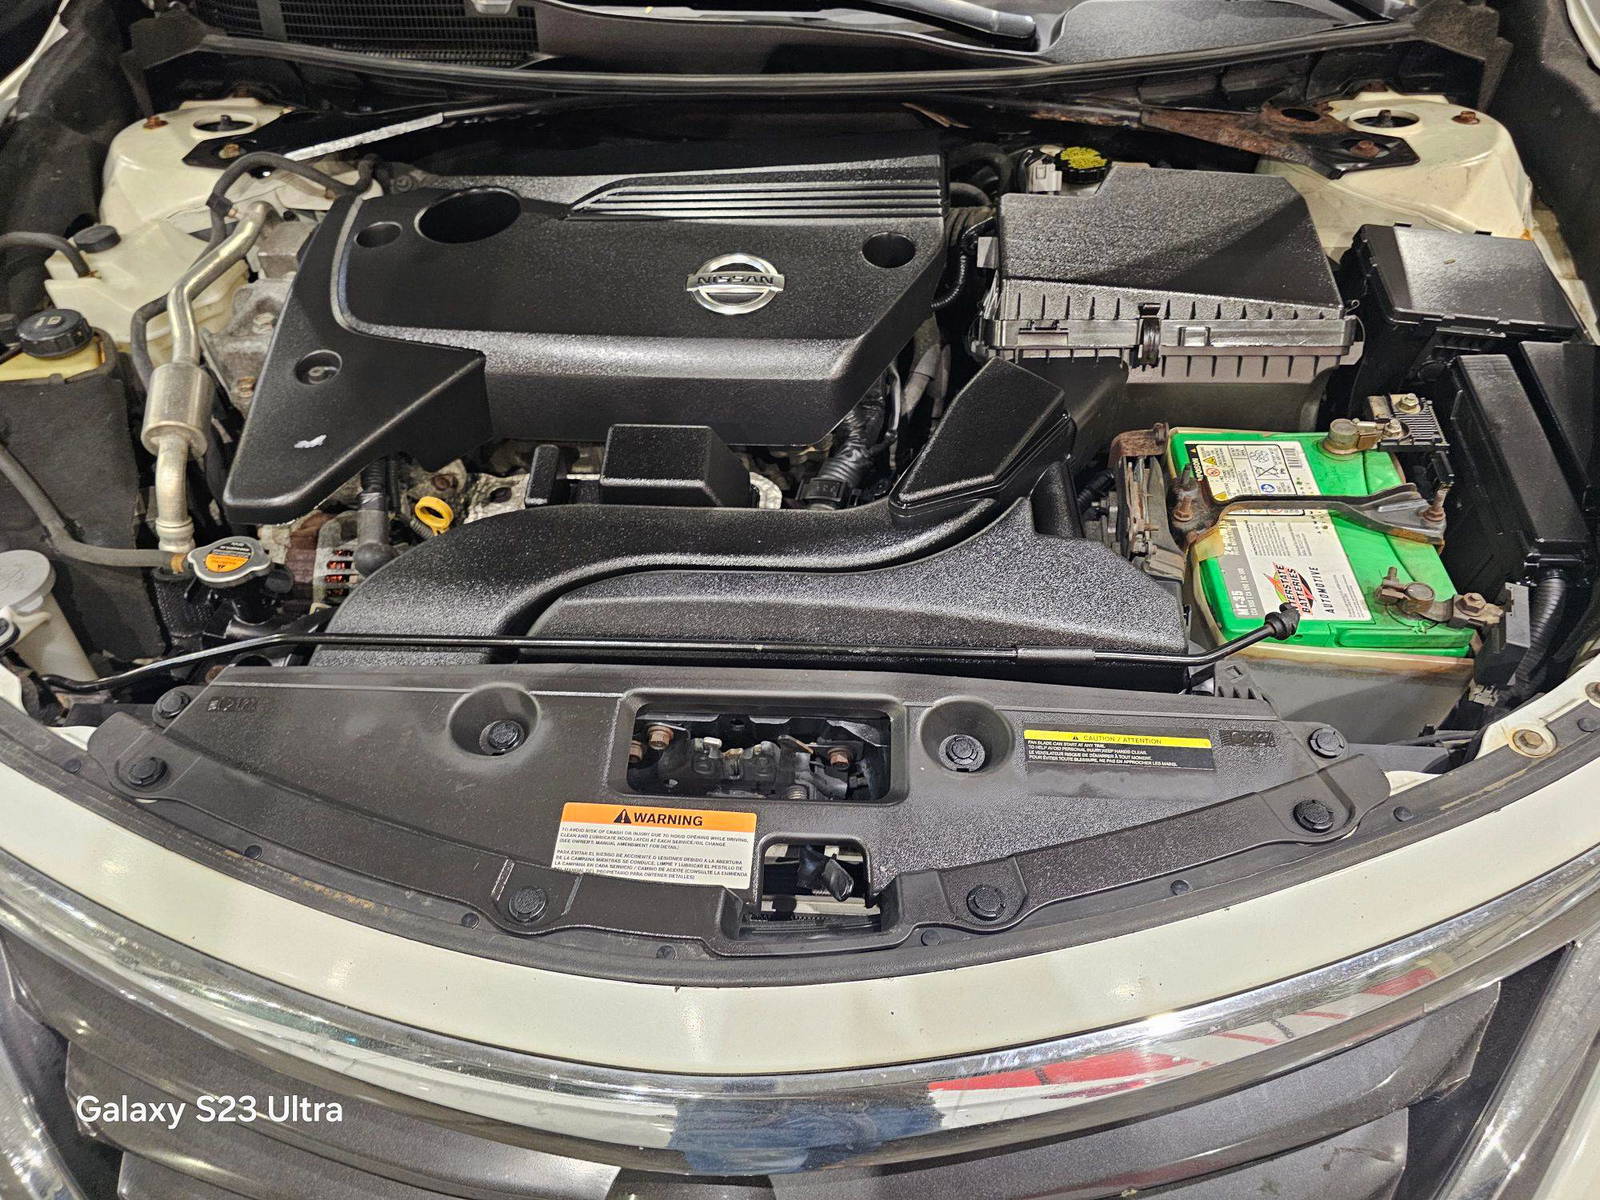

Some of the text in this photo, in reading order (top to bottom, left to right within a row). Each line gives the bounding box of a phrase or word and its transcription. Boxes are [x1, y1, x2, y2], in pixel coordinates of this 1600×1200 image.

[697, 275, 774, 285] NISSAN
[1288, 569, 1310, 612] BATTERIES
[1309, 567, 1335, 614] AUTOMOTIVE
[634, 812, 703, 826] WARNING
